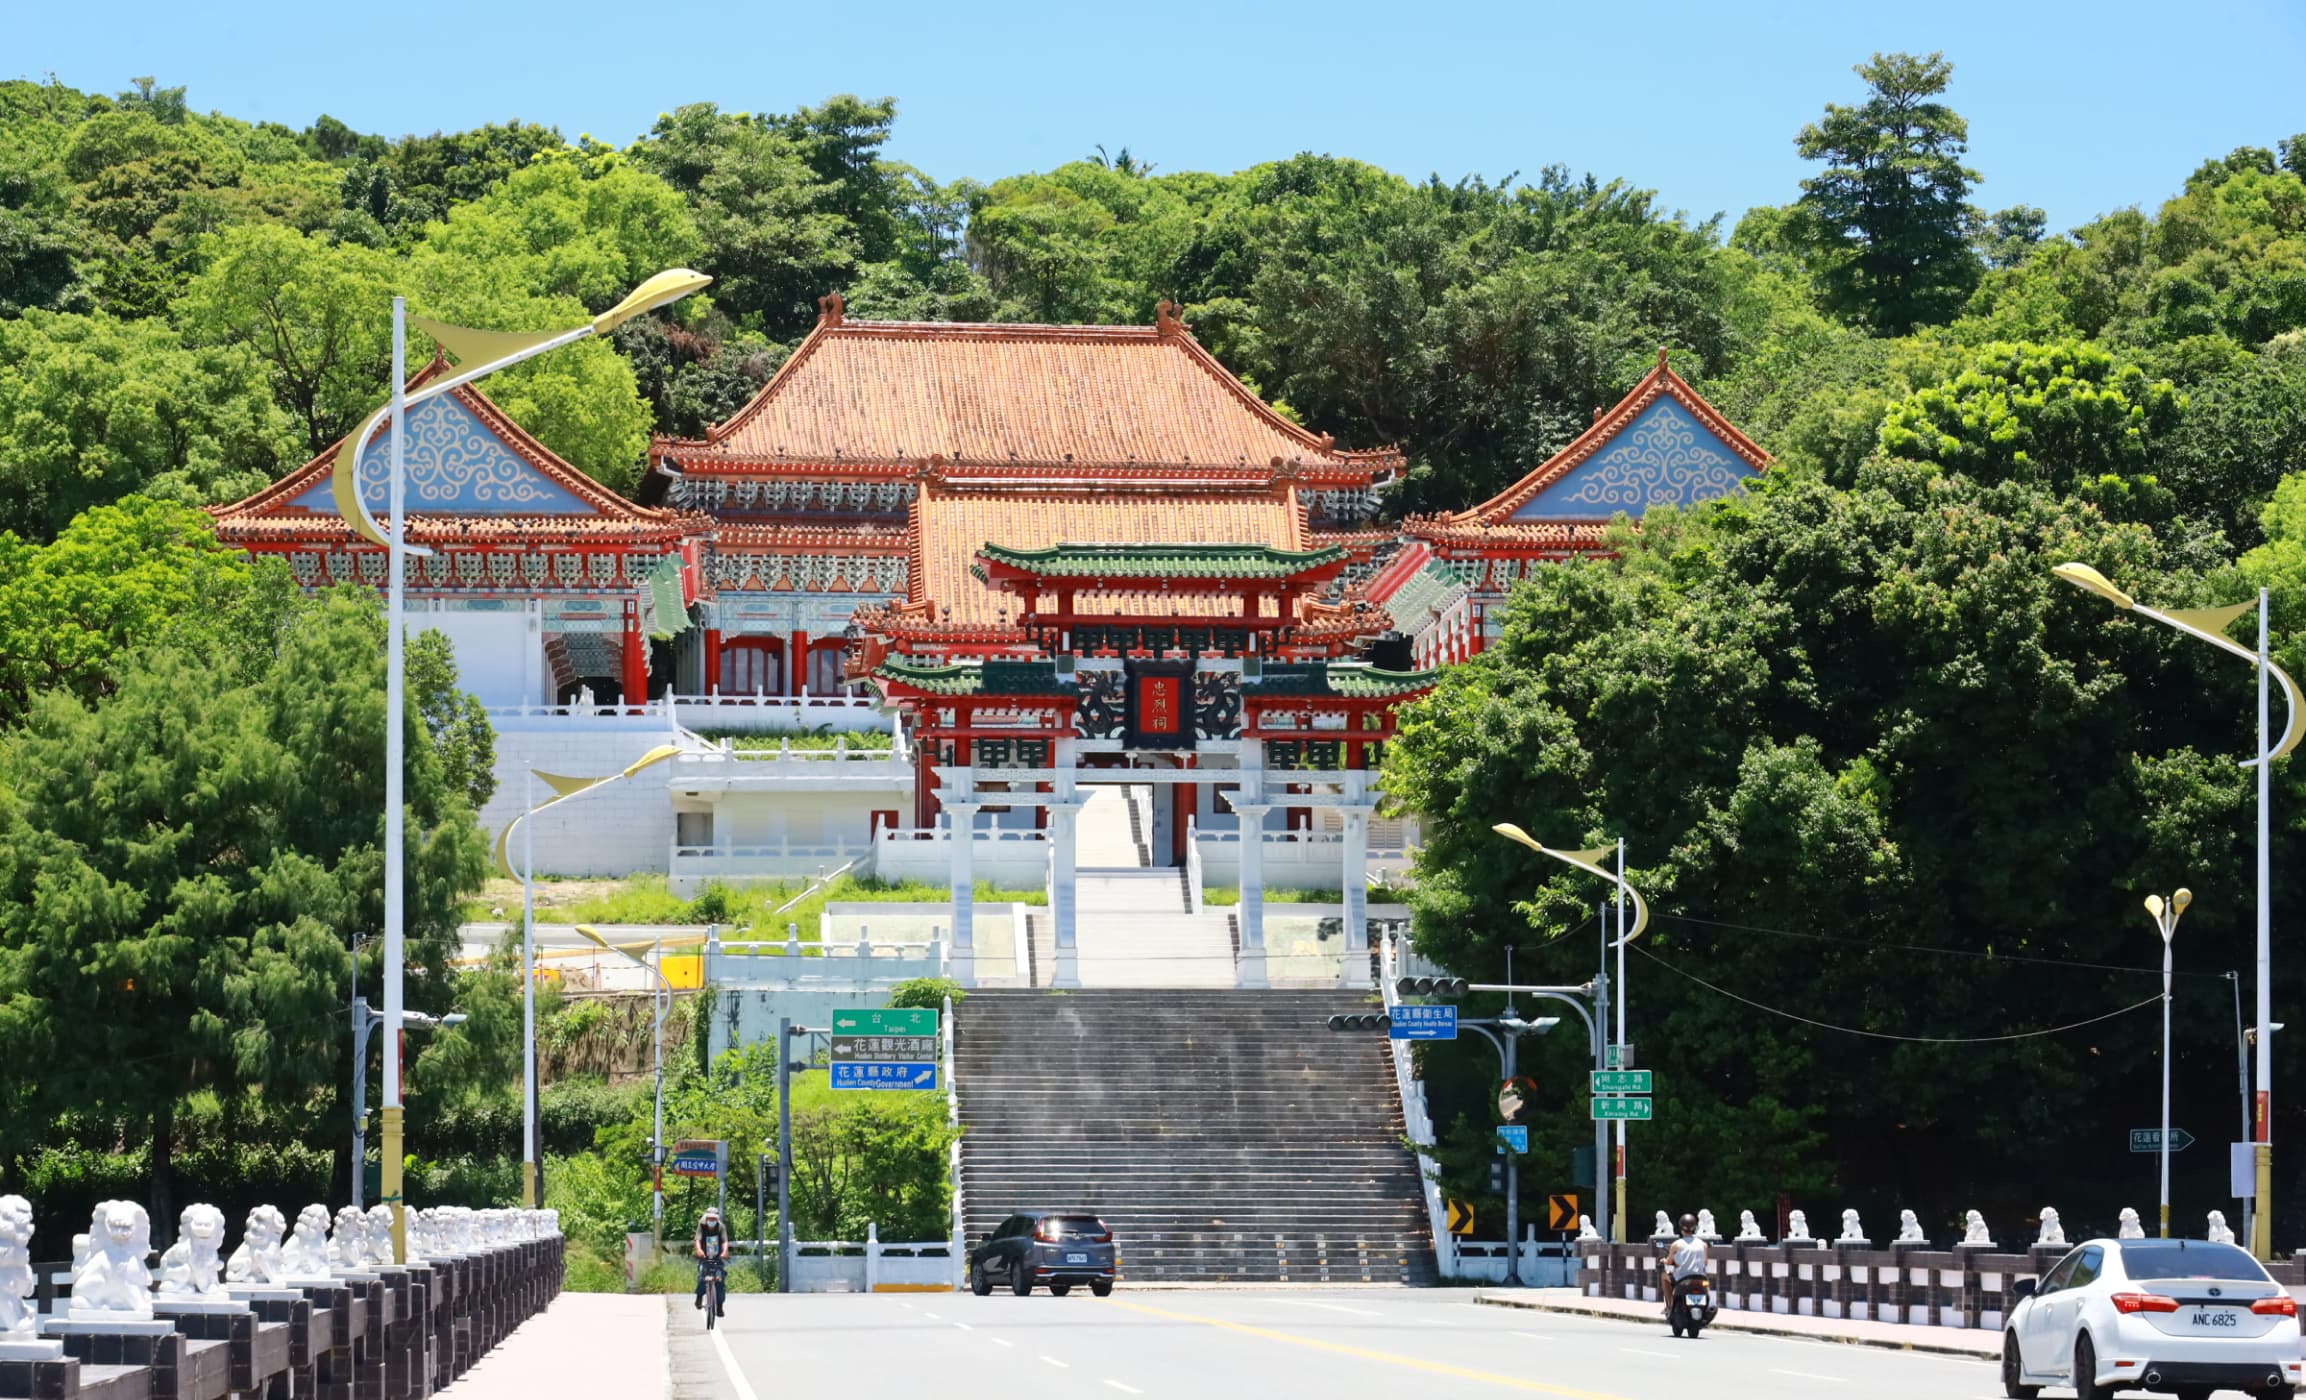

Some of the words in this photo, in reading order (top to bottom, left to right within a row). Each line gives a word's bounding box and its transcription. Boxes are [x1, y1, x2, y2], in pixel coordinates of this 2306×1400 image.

[1152, 680, 1168, 730] 忠烈祠
[872, 1013, 921, 1024] 台北
[1391, 1007, 1453, 1019] 花蓮縣衛生局
[884, 1025, 906, 1034] Taipei
[854, 1038, 934, 1051] 花蓮觀光酒廠
[838, 1066, 909, 1078] 花蓮縣政府
[2133, 1131, 2179, 1143] 花蓮看所
[2192, 1313, 2210, 1326] ANC
[2212, 1313, 2236, 1326] 6825
